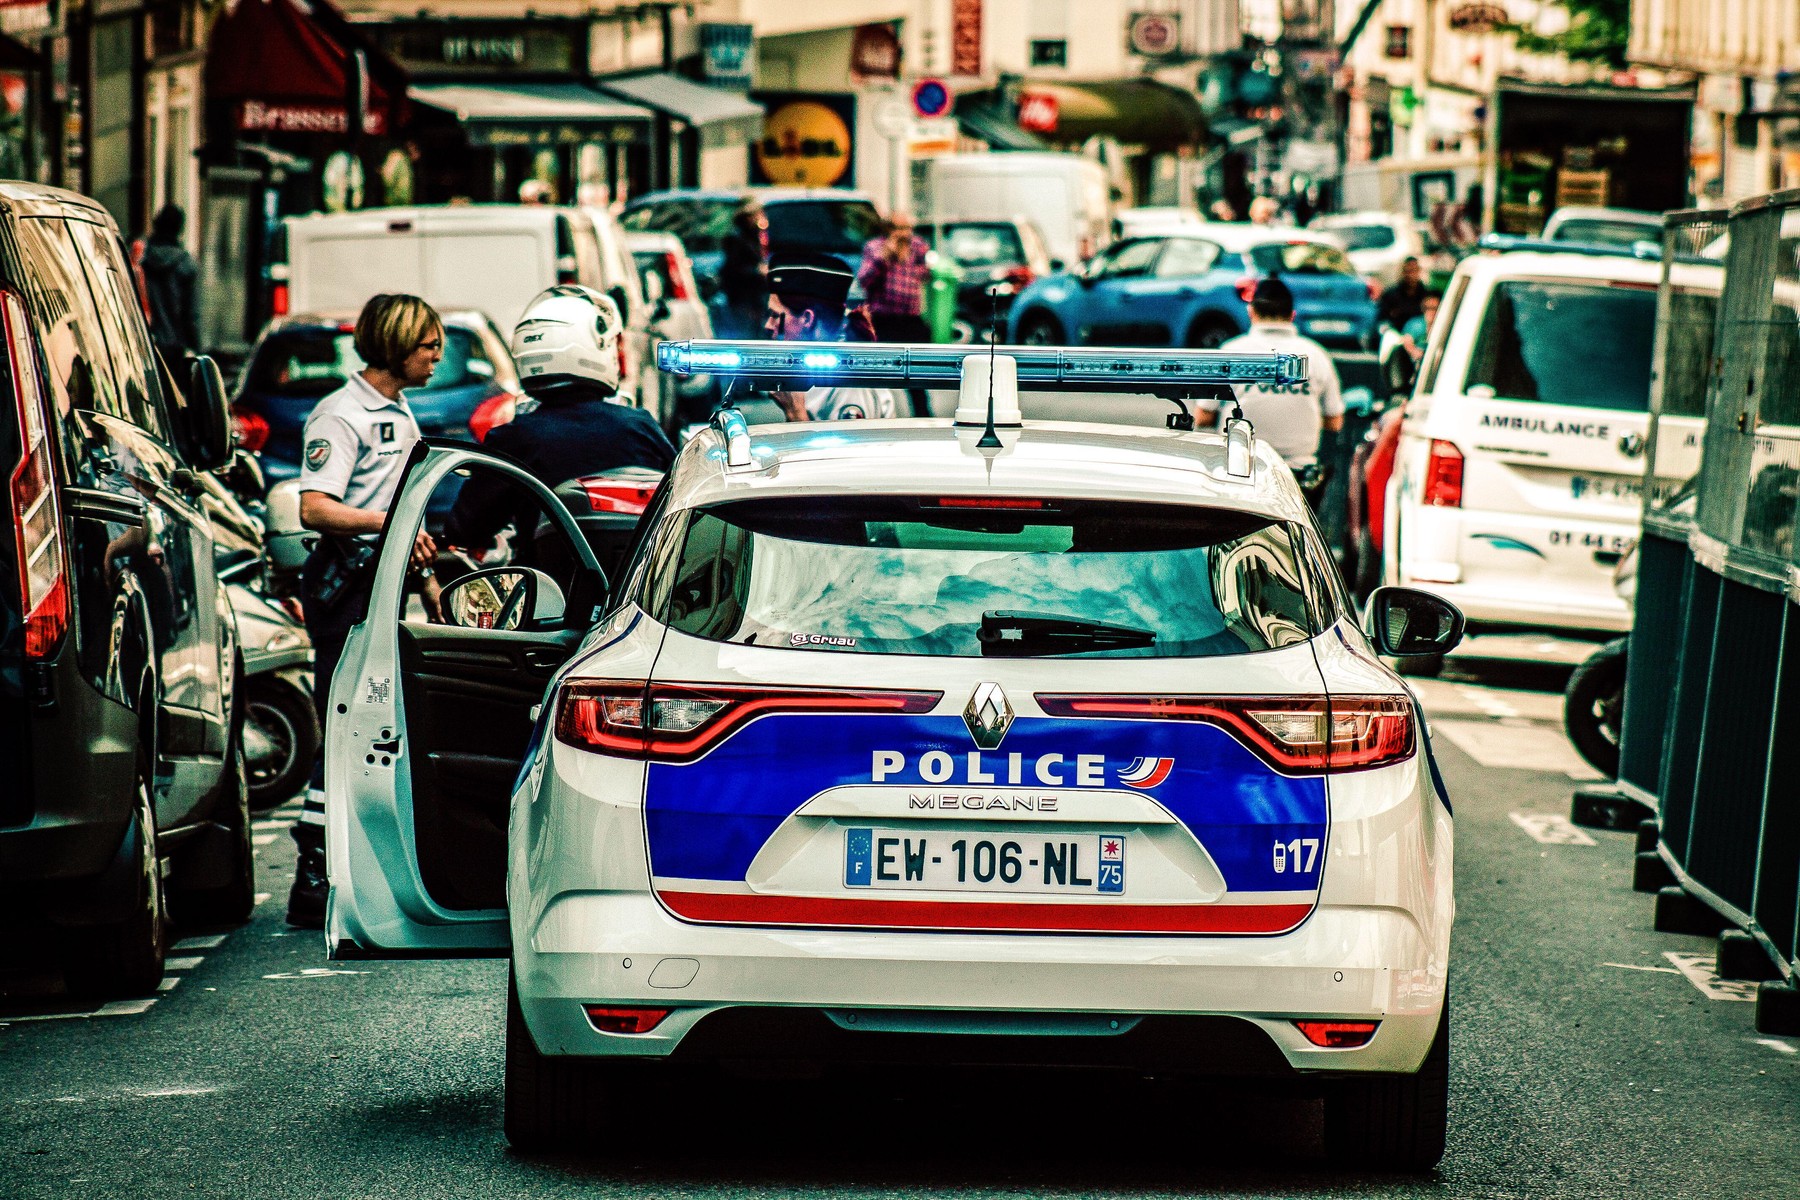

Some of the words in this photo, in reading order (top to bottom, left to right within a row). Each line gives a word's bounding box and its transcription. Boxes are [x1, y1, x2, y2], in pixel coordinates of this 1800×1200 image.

[243, 100, 377, 134] Brassere
[1480, 414, 1609, 439] AMBULANCE
[1549, 530, 1571, 545] 01
[809, 634, 856, 648] Gruau
[871, 750, 1106, 787] POLICE
[908, 793, 1059, 812] MEGANE
[855, 861, 863, 874] F
[877, 837, 1093, 886] EW-106-NL
[1100, 864, 1122, 885] 75
[1287, 838, 1320, 873] 17
